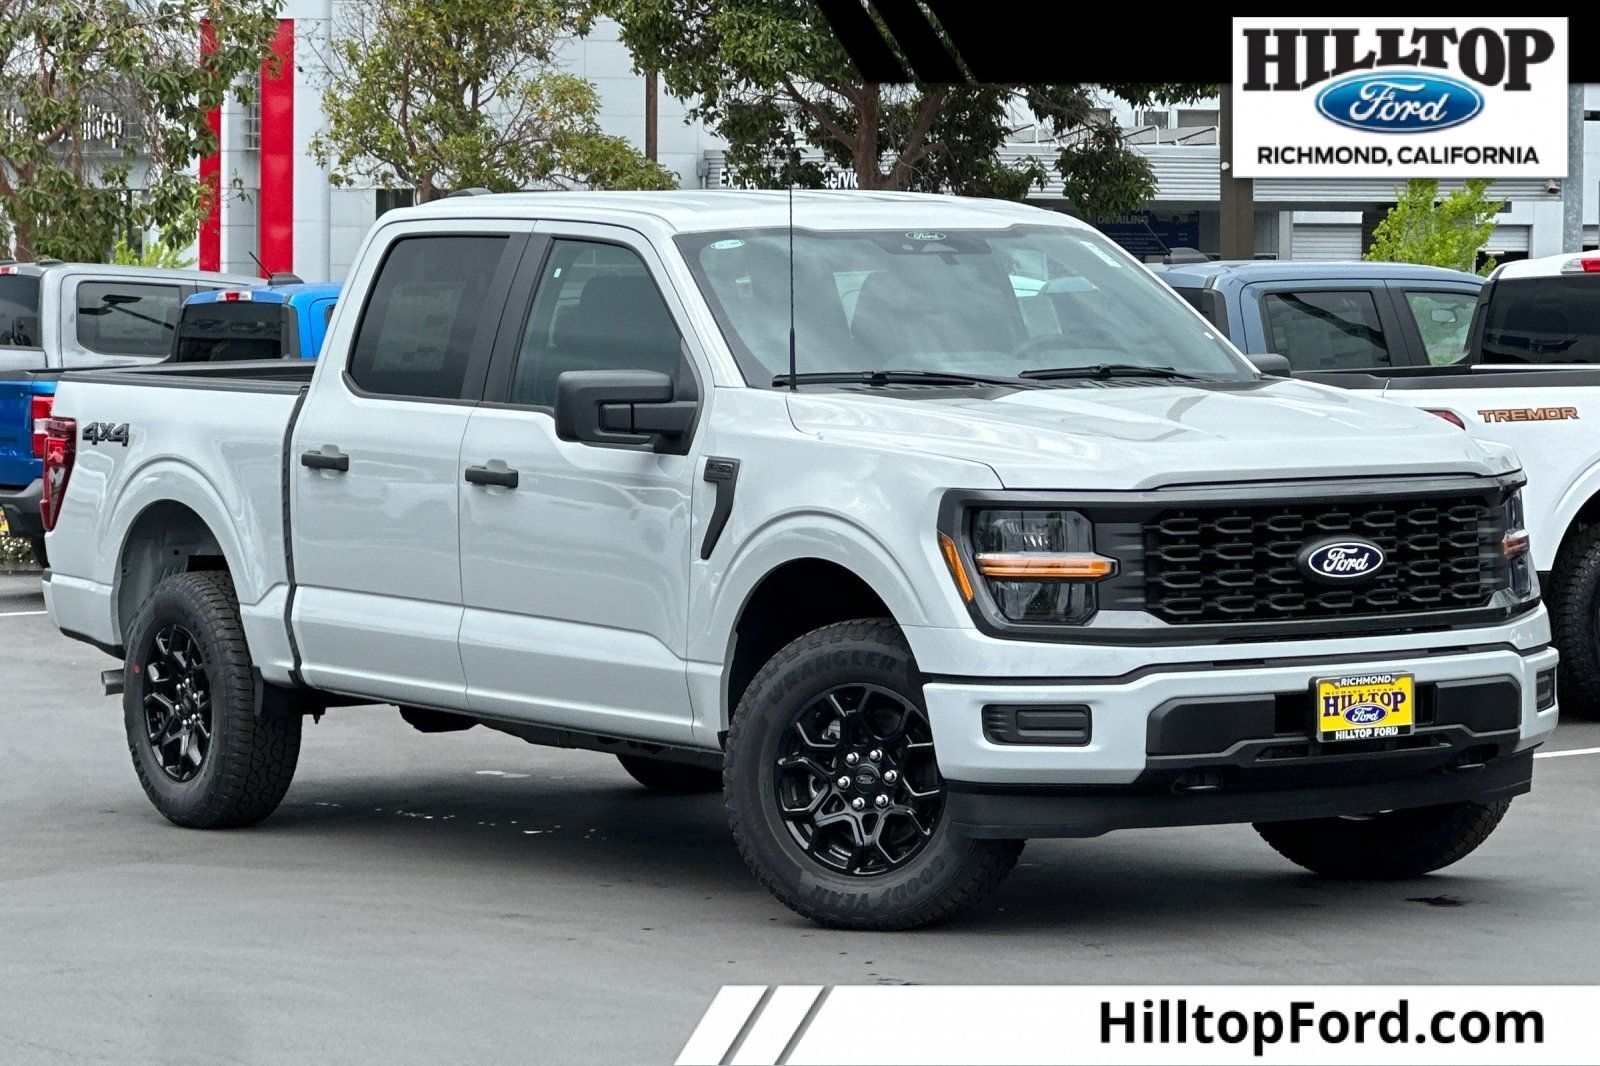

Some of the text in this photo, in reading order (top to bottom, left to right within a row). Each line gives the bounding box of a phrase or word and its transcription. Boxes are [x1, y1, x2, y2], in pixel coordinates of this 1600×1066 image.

[1477, 406, 1580, 423] TREMOR
[1323, 547, 1369, 572] Ford
[1341, 675, 1392, 686] RICHMOND
[1323, 691, 1406, 717] HILLTOP
[1351, 706, 1379, 722] Ford
[1335, 726, 1398, 740] HILLTOP FORD
